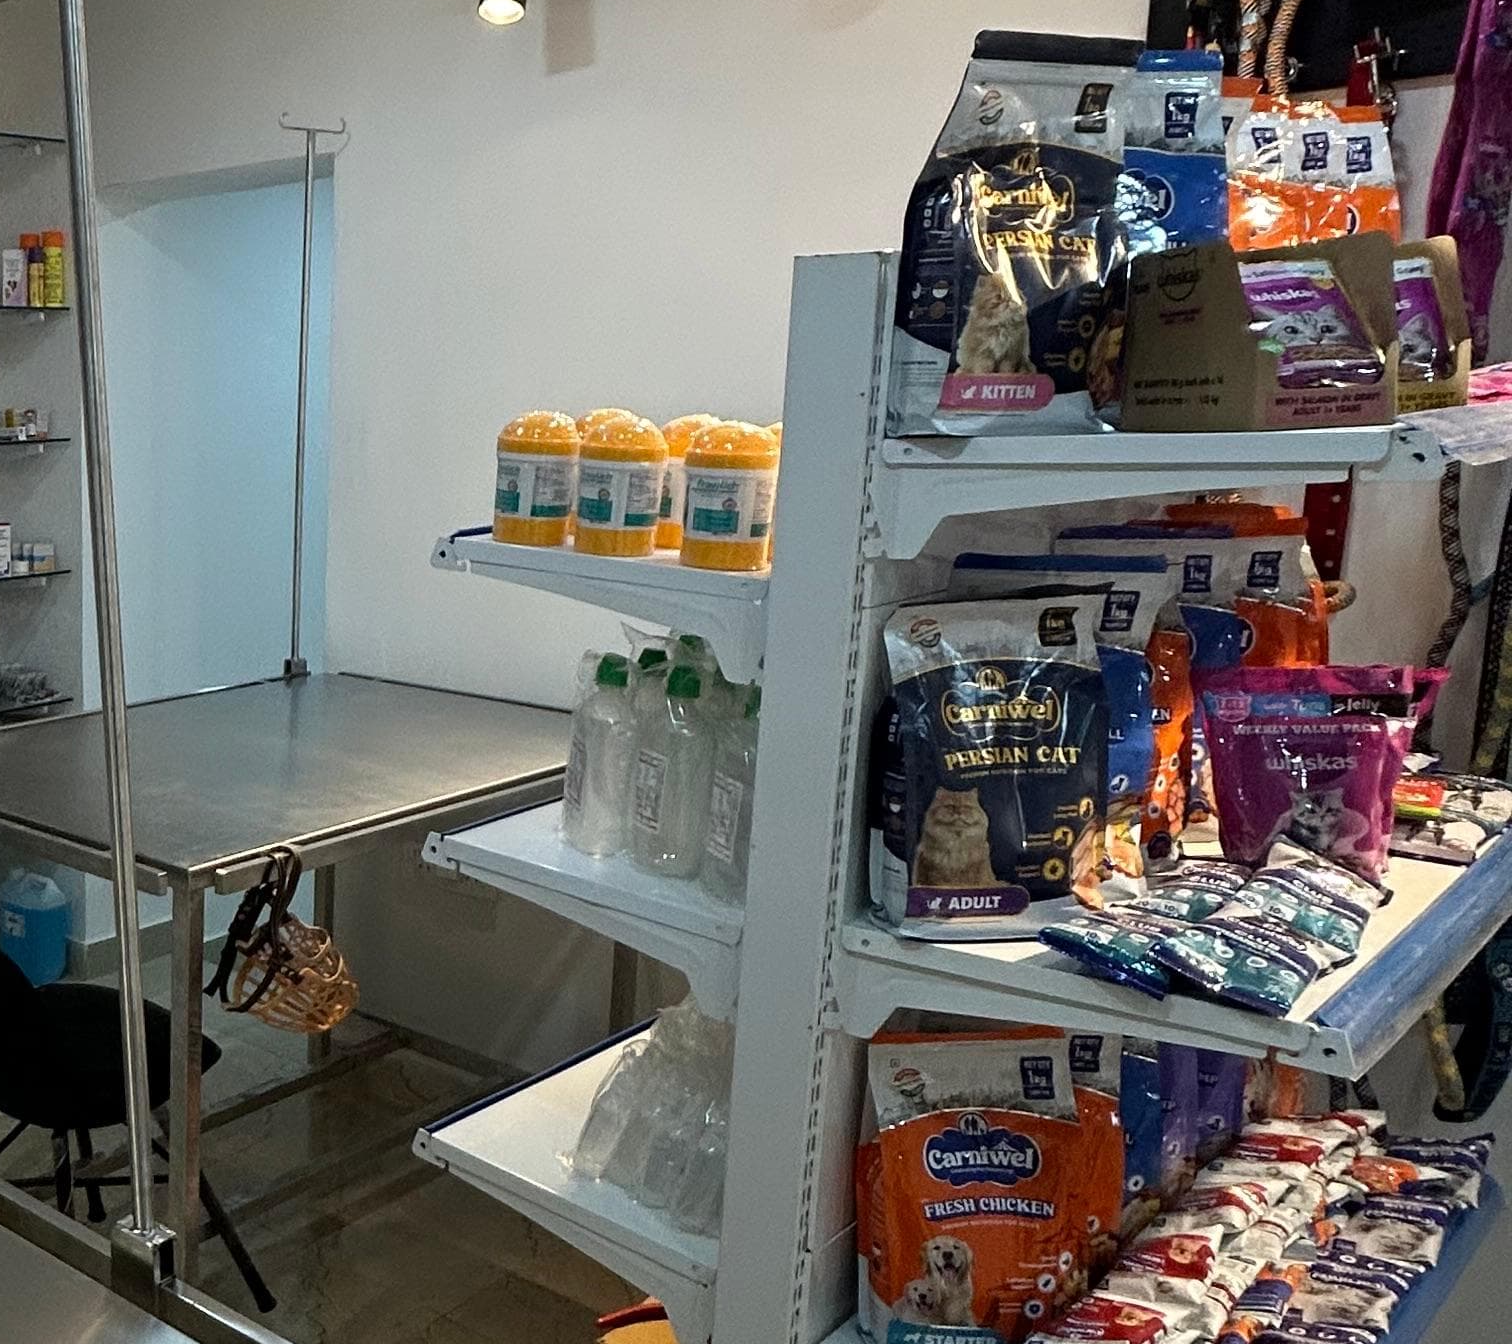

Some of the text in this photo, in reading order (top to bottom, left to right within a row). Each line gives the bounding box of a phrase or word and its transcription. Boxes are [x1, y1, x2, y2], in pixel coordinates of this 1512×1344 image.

[981, 385, 1037, 400] KITTEN
[945, 699, 1055, 724] Carniwel
[1346, 698, 1380, 712] Jelly
[1233, 723, 1288, 735] WEEKLY
[1291, 723, 1339, 734] VALUE
[944, 744, 1082, 771] PERSIAN CAT
[1266, 753, 1359, 770] whiskas
[948, 895, 1003, 911] ADULT
[1234, 928, 1282, 953] CLUB
[928, 1145, 1035, 1169] Carniwel
[924, 1197, 1055, 1218] FRESH CHICKEN
